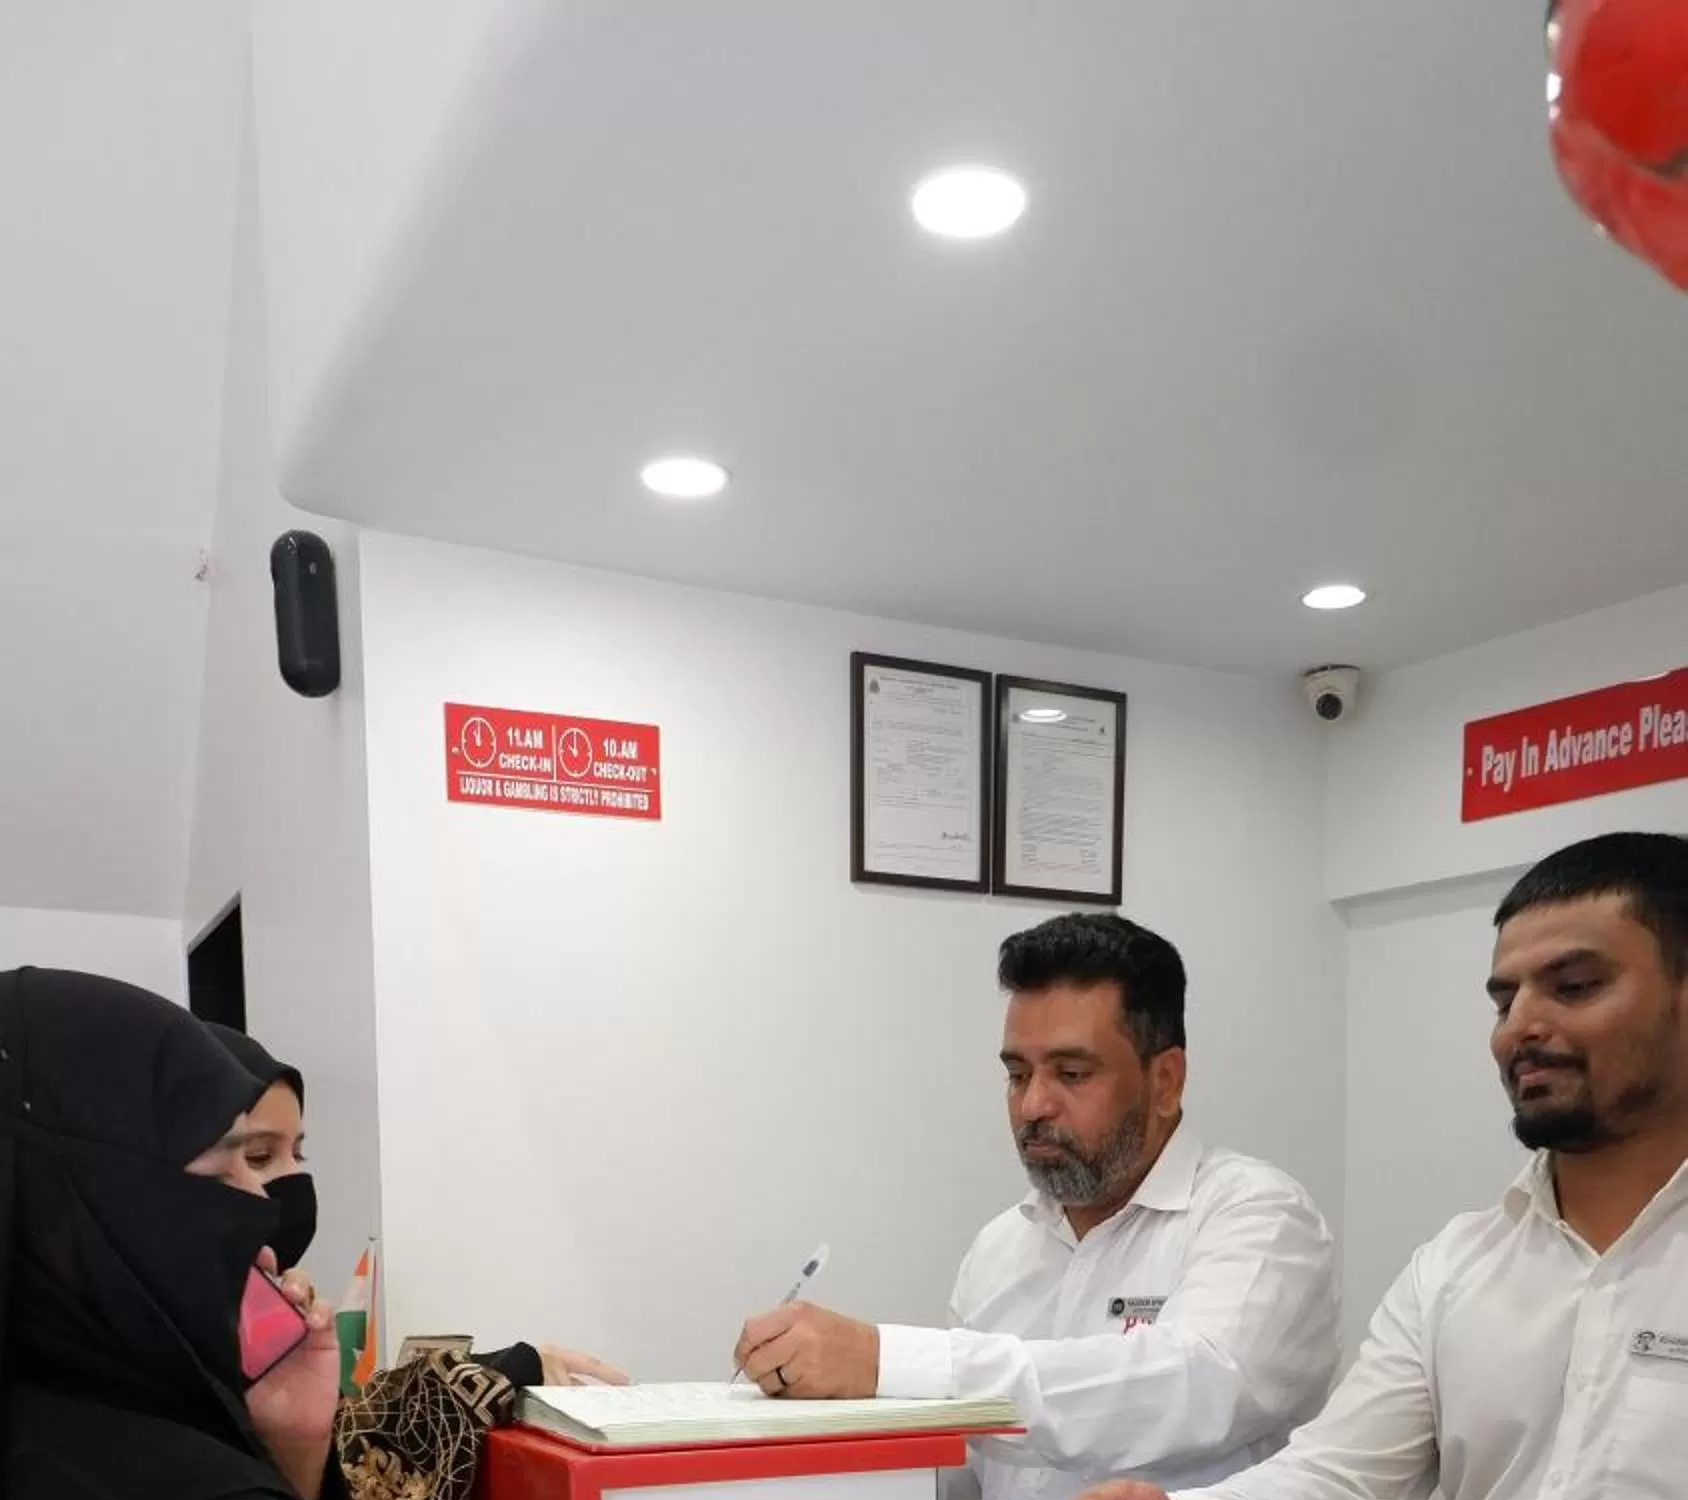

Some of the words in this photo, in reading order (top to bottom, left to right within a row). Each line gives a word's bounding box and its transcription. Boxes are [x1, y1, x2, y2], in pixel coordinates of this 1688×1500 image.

[506, 726, 544, 749] 11.AM
[603, 737, 637, 760] 10.AM
[499, 752, 552, 773] CHECK-IN
[1481, 745, 1516, 793] Pay
[1520, 736, 1539, 778] In
[1544, 724, 1633, 774] Advance
[593, 761, 647, 783] CHECK-OUT
[460, 776, 493, 797] LIQUOR
[495, 779, 502, 797] &
[503, 780, 548, 801] GAMBLING
[549, 784, 559, 802] IS
[560, 785, 598, 806] STRICTLY
[600, 789, 649, 812] PROHIBITED
